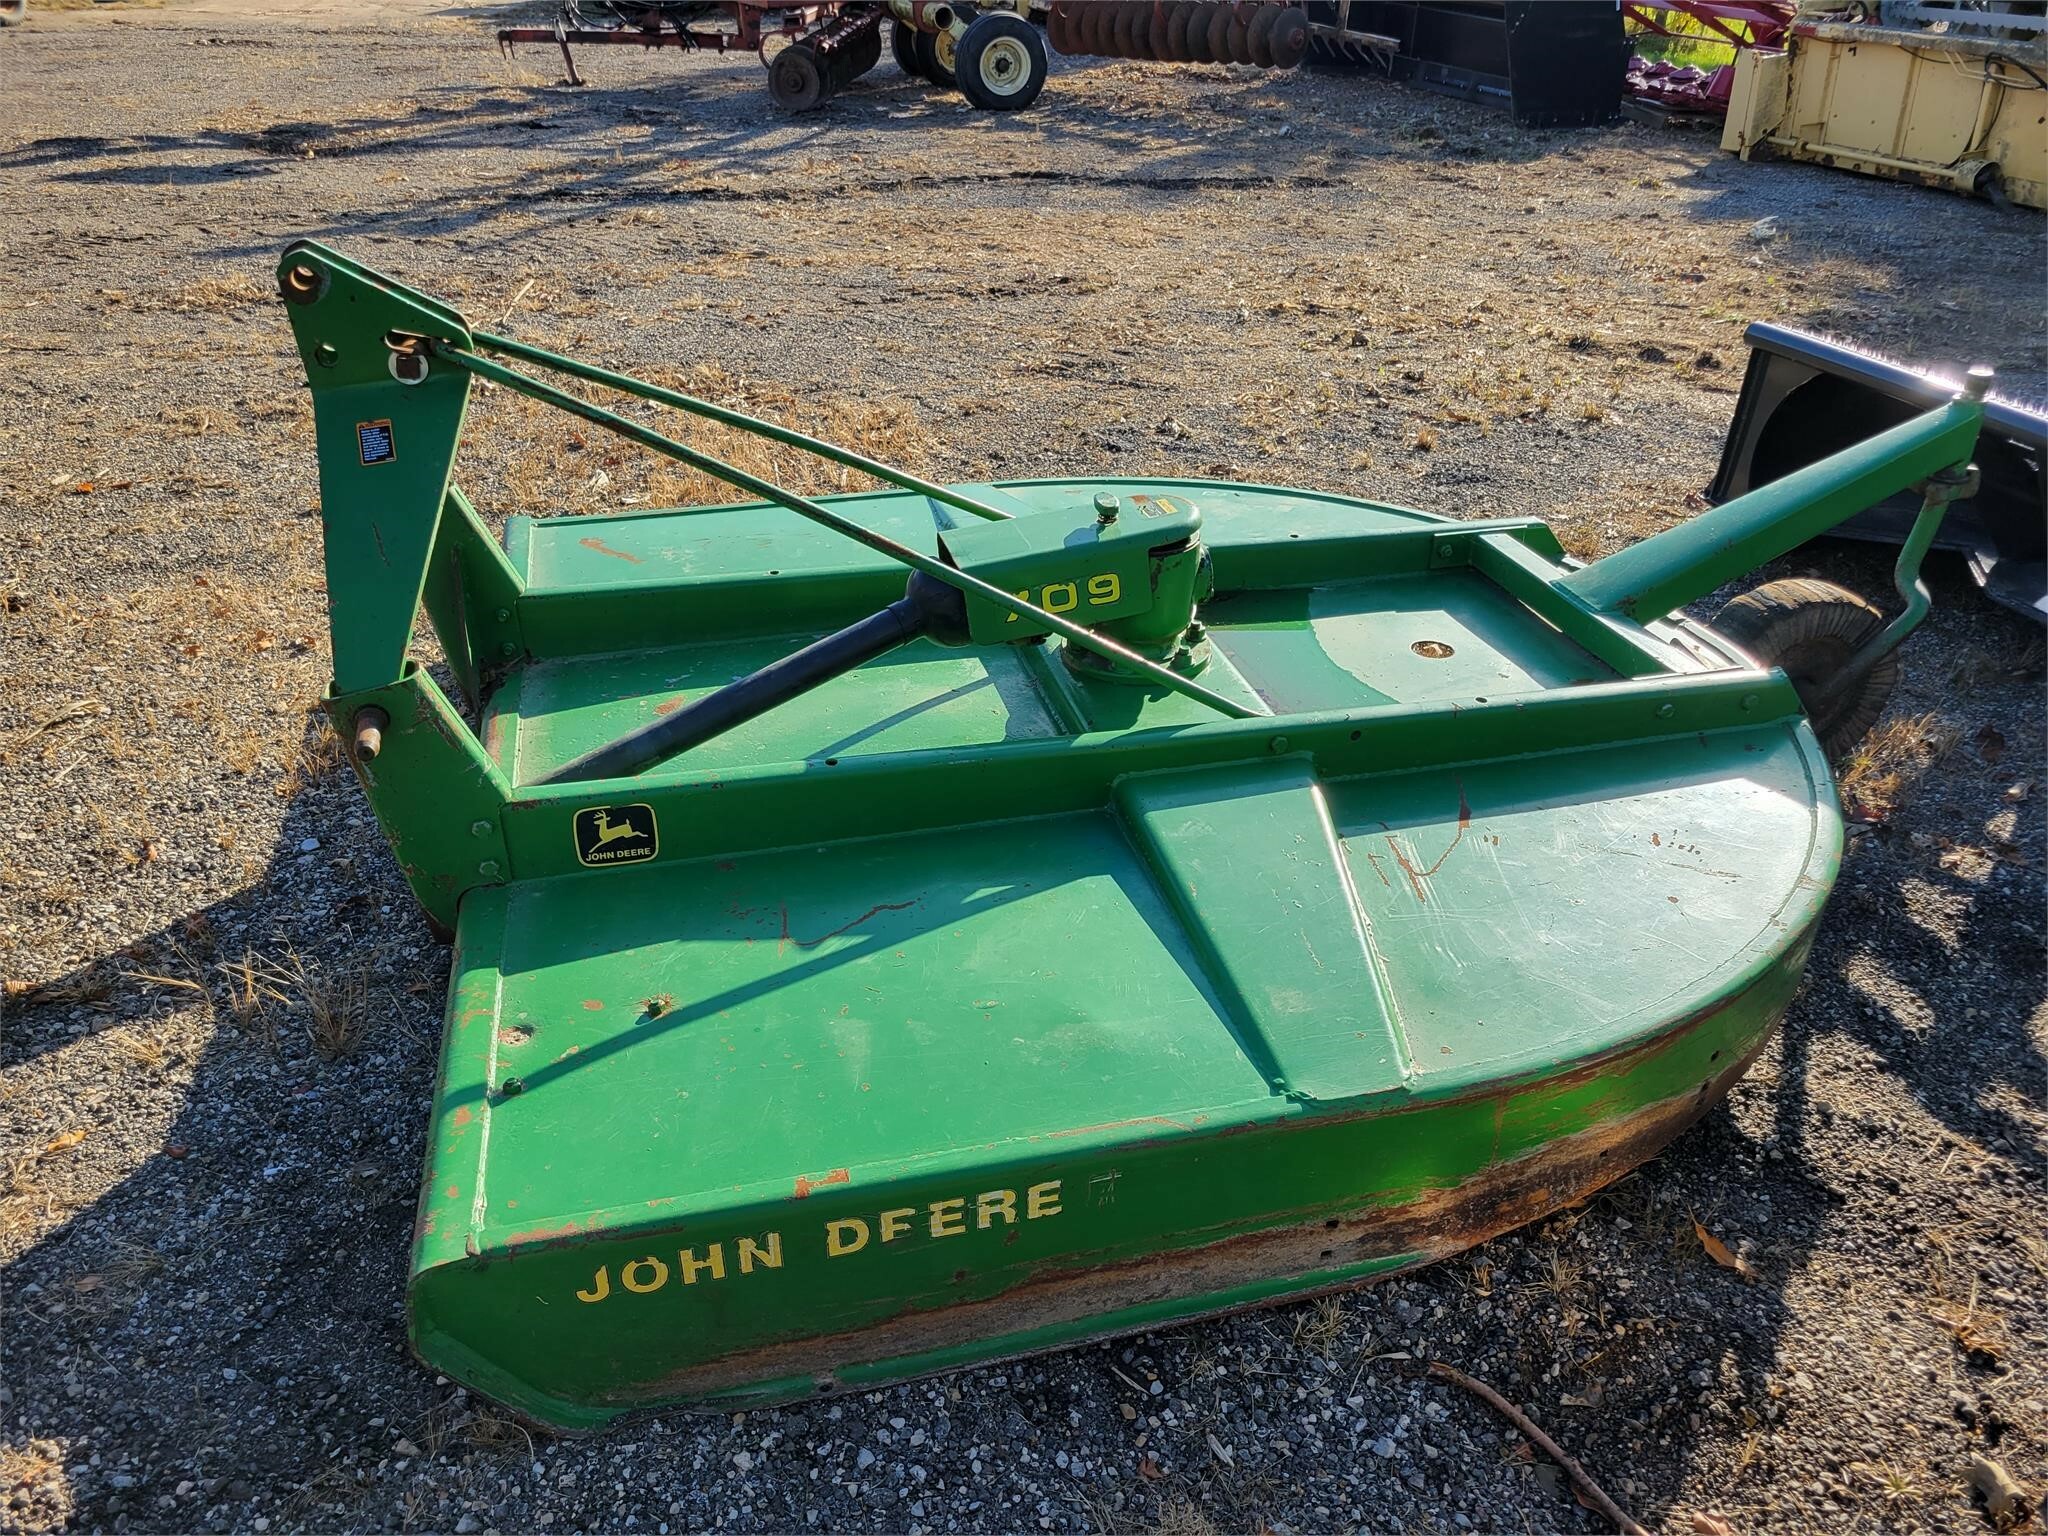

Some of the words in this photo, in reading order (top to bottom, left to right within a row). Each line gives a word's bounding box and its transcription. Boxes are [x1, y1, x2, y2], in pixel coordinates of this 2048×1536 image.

[586, 851, 615, 862] JOHN
[617, 847, 652, 858] DEERE
[575, 1232, 782, 1303] JOHN
